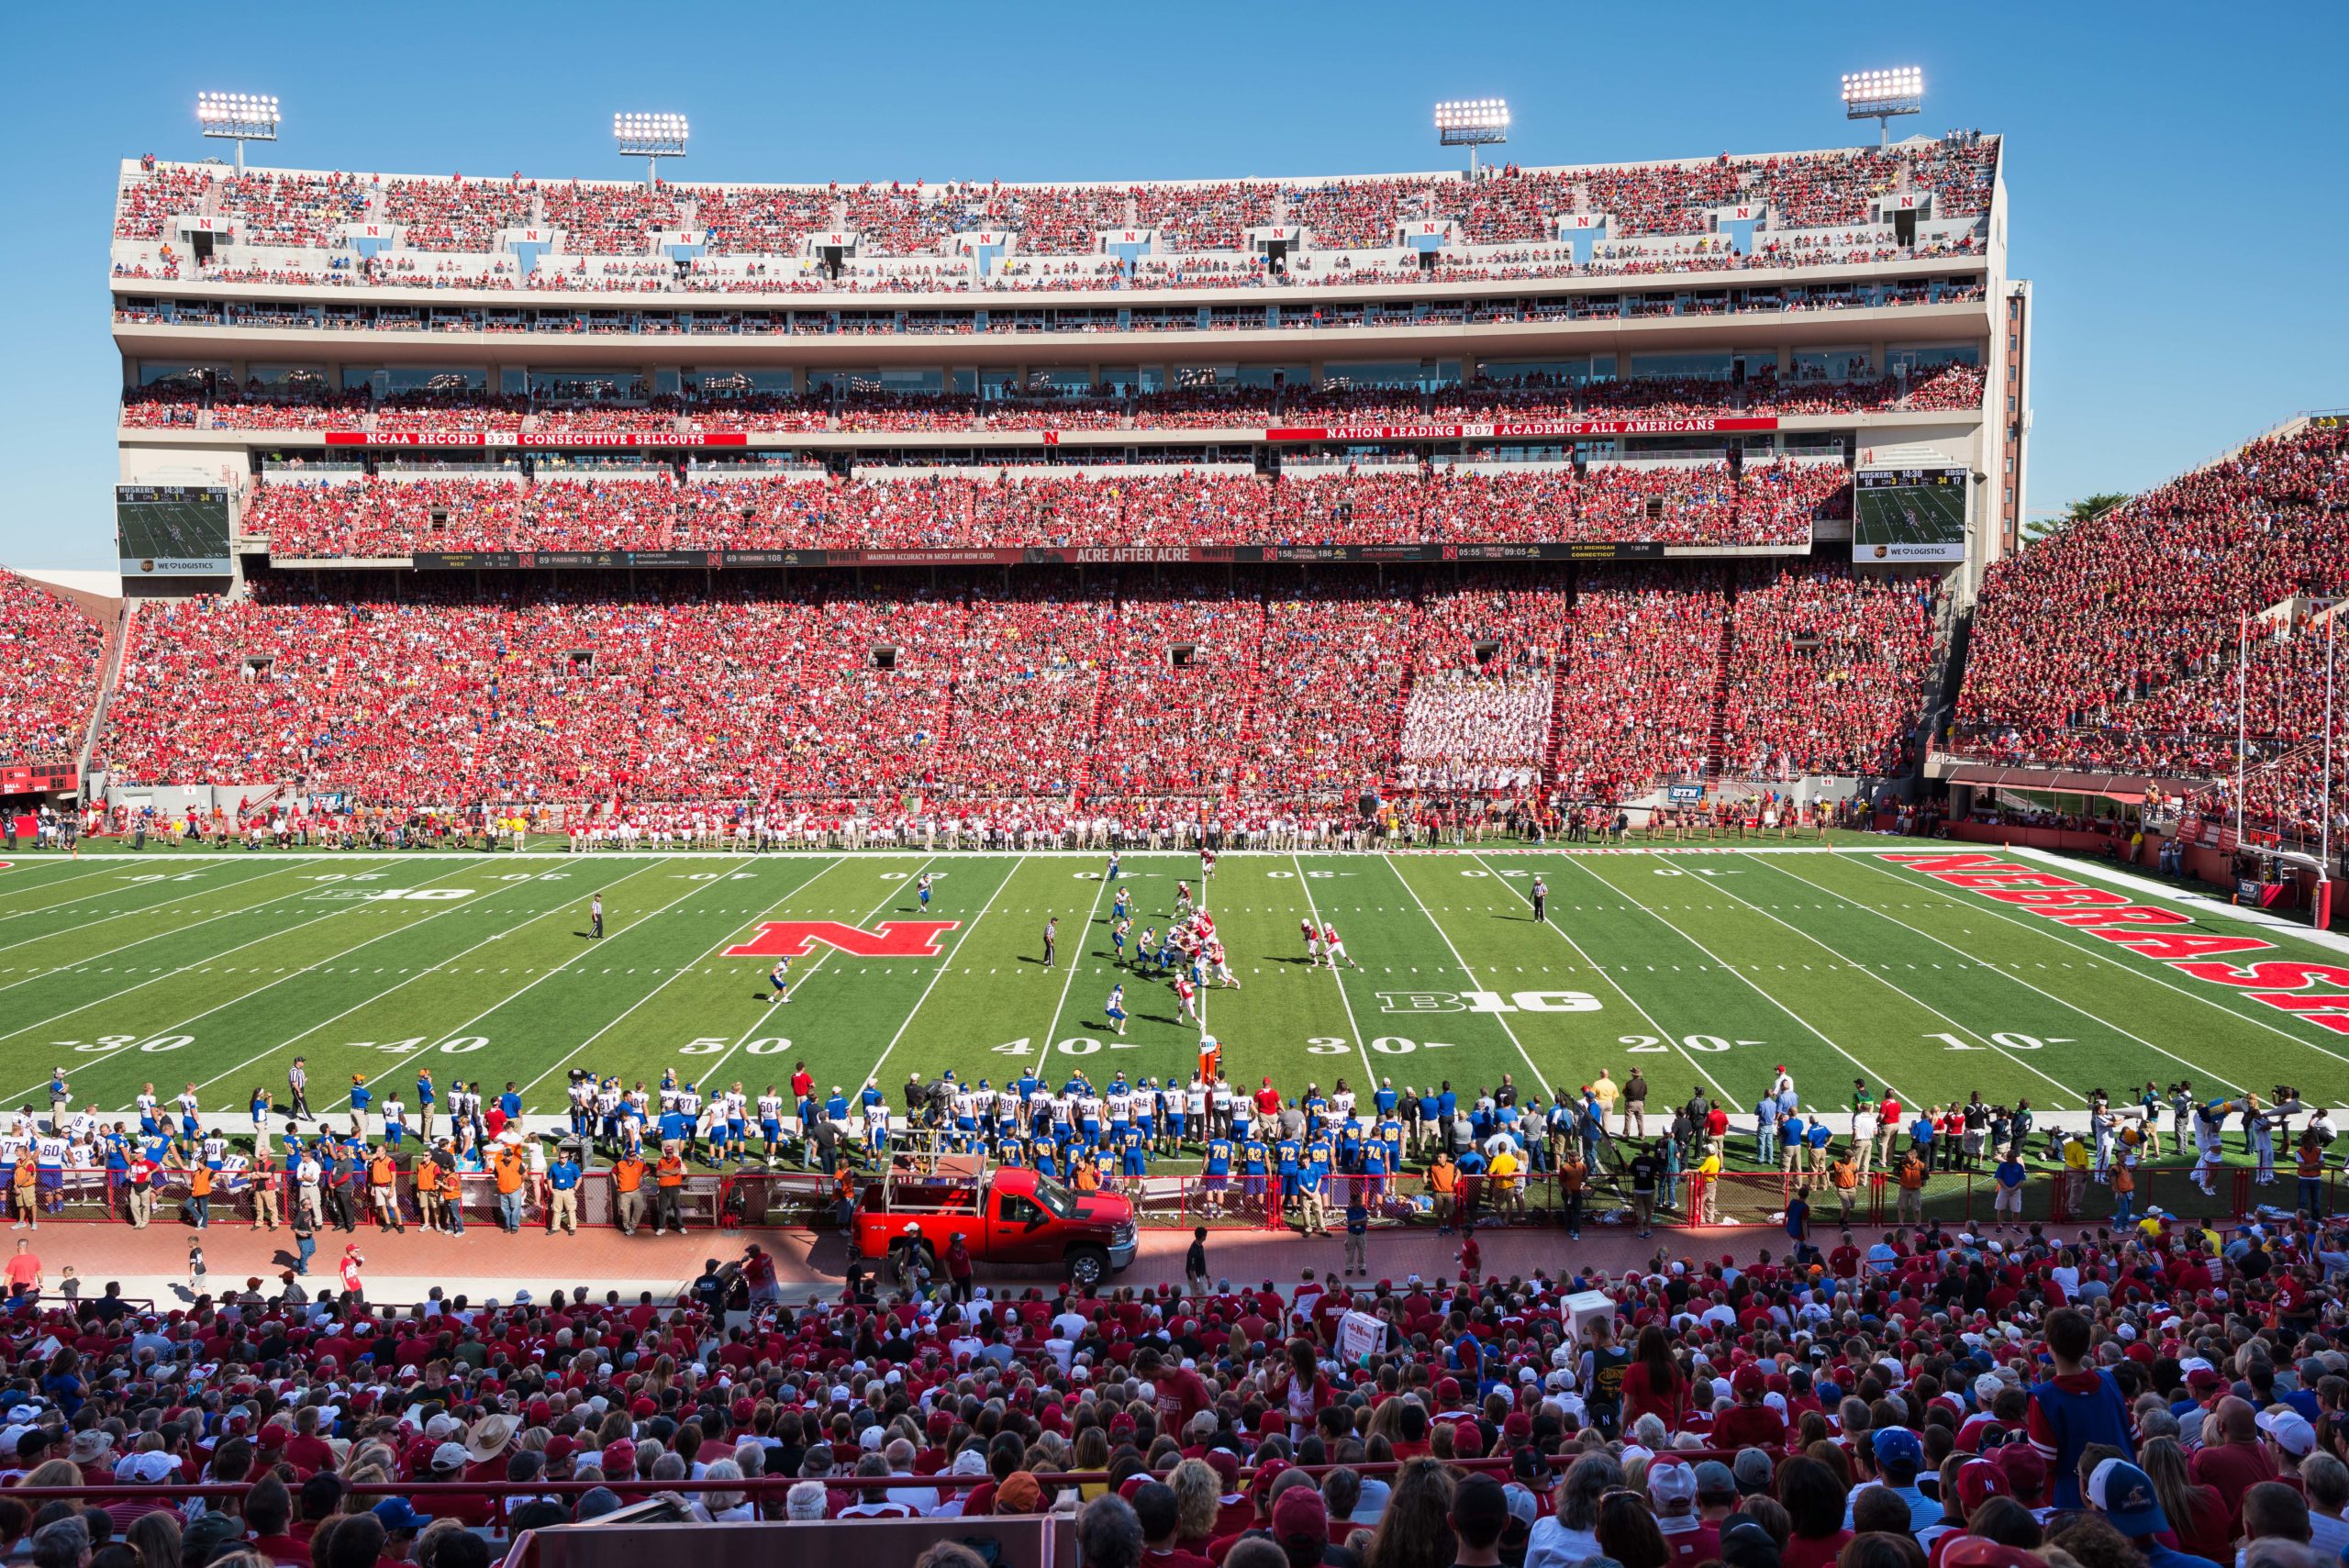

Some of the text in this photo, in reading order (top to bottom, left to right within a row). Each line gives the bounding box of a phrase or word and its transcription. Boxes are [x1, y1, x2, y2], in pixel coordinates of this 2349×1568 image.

[1901, 197, 1913, 207] N
[1737, 208, 1748, 218] N
[200, 219, 212, 229] N
[1578, 217, 1589, 226] N
[367, 226, 378, 235] N
[1273, 228, 1284, 238] N
[1424, 223, 1435, 233] N
[527, 231, 538, 240] N
[681, 234, 692, 243] N
[832, 234, 842, 244] N
[981, 234, 990, 243] N
[1125, 232, 1135, 241] N
[1327, 420, 1715, 438] NATION LEADING 307 ACADEMIC ALL AMERICANS
[366, 434, 705, 445] NCAA RECORD 329 CONSECUTIVE SELLOUTS
[1044, 431, 1059, 445] N
[1077, 548, 1189, 562] ACRE AFTER ACRE
[1263, 547, 1278, 560] N
[1442, 546, 1458, 559] N
[519, 554, 535, 568] N
[707, 552, 722, 566] N
[719, 921, 963, 957] N
[74, 1035, 195, 1052] 30
[375, 1036, 489, 1053] 40
[679, 1037, 793, 1054] 50
[991, 1037, 1102, 1055] 40
[1306, 1036, 1417, 1055] 30
[1617, 1034, 1731, 1052] 20
[1923, 1032, 2043, 1051] 10
[679, 1099, 692, 1109] 37
[1169, 1095, 1175, 1105] 7
[1083, 1105, 1094, 1114] 54
[1114, 1103, 1126, 1113] 91
[1234, 1102, 1246, 1112] 45
[872, 1113, 883, 1123] 21
[43, 1144, 59, 1156] 60
[1213, 1145, 1228, 1159] 78
[1280, 1147, 1295, 1161] 72
[1367, 1147, 1381, 1160] 74
[1602, 1415, 1610, 1425] N
[1984, 1480, 1995, 1491] N
